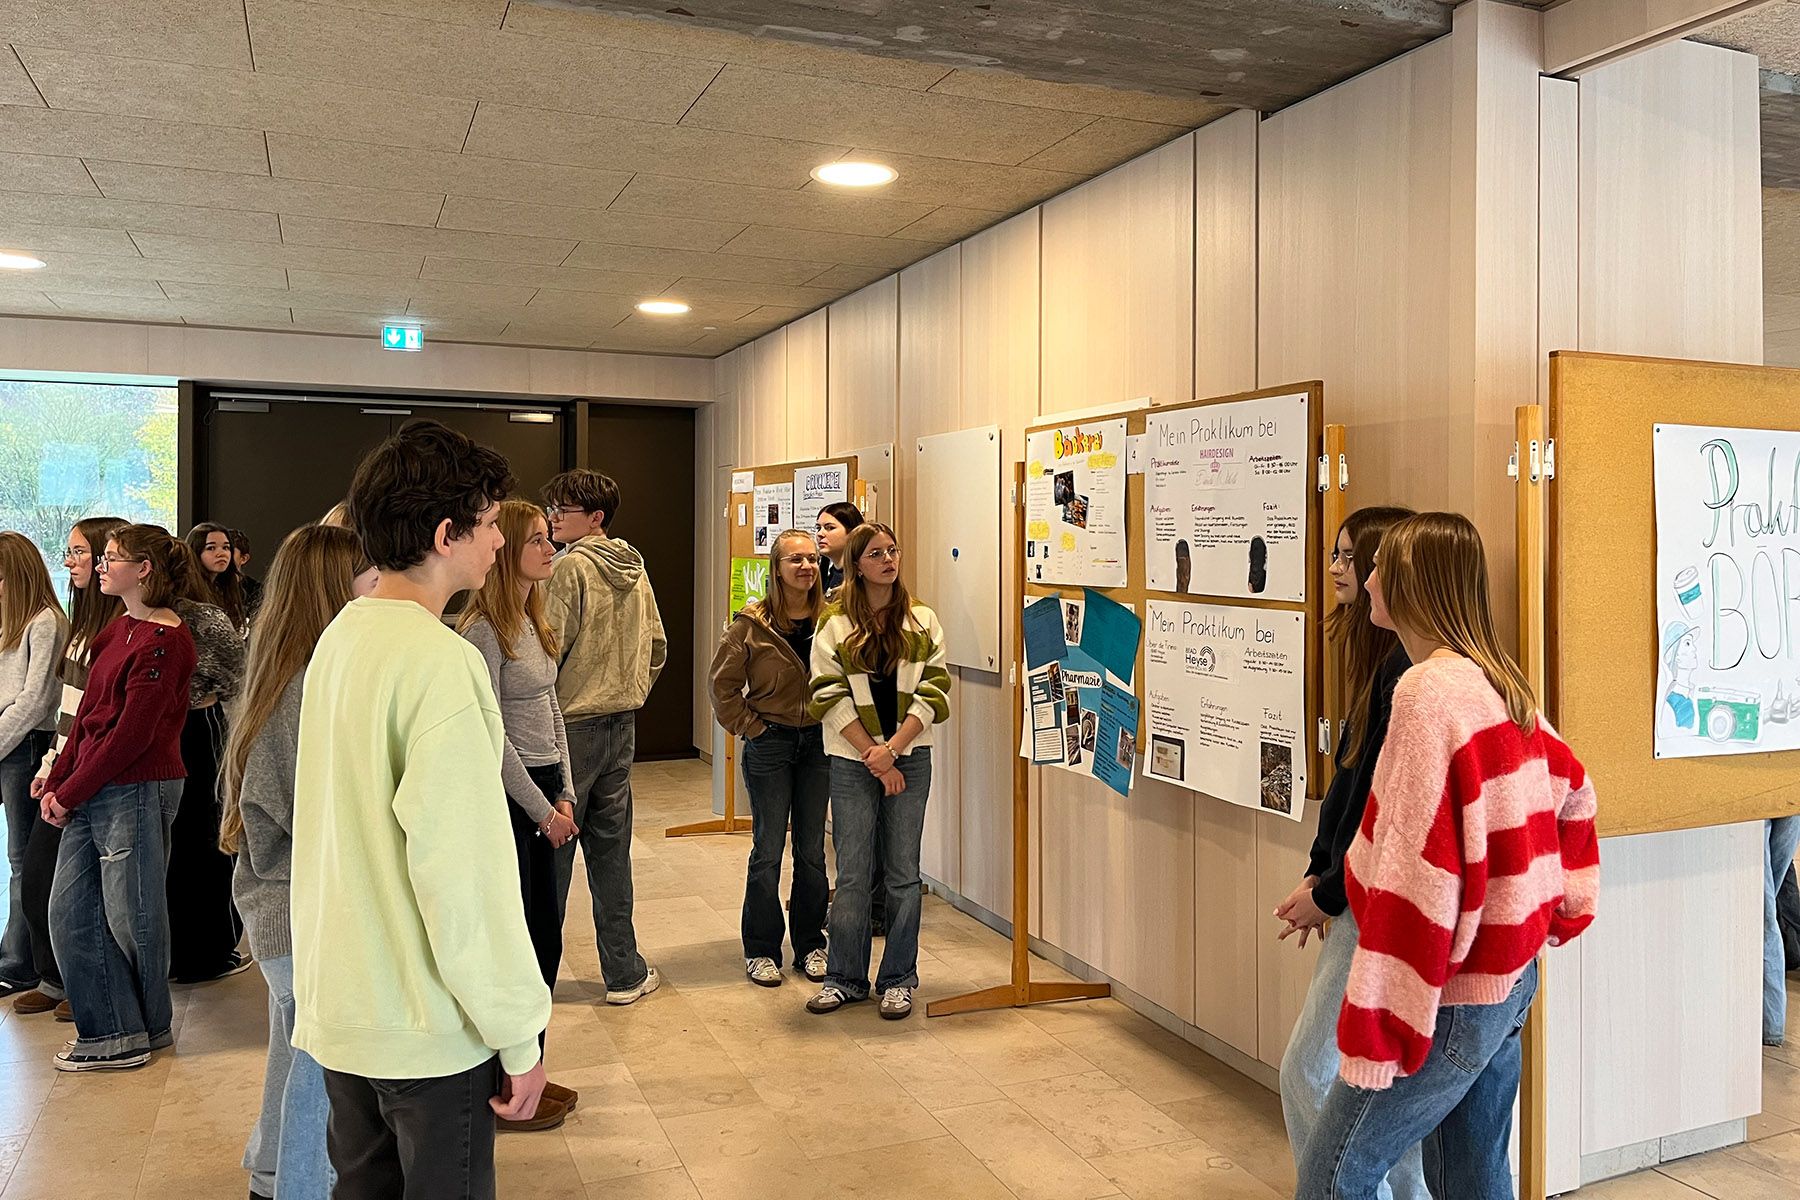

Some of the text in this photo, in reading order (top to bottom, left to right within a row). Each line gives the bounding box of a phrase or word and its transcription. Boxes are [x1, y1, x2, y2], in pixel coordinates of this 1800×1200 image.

[1159, 424, 1186, 447] Mein
[1258, 416, 1277, 438] bei
[1054, 427, 1103, 459] Bäckerei
[1131, 450, 1136, 460] 4
[1199, 447, 1234, 459] HAIRDESIGN
[1151, 610, 1275, 644] Mein Praktikum bei
[1185, 654, 1208, 667] Heyse
[1061, 670, 1101, 687] Pharmazie
